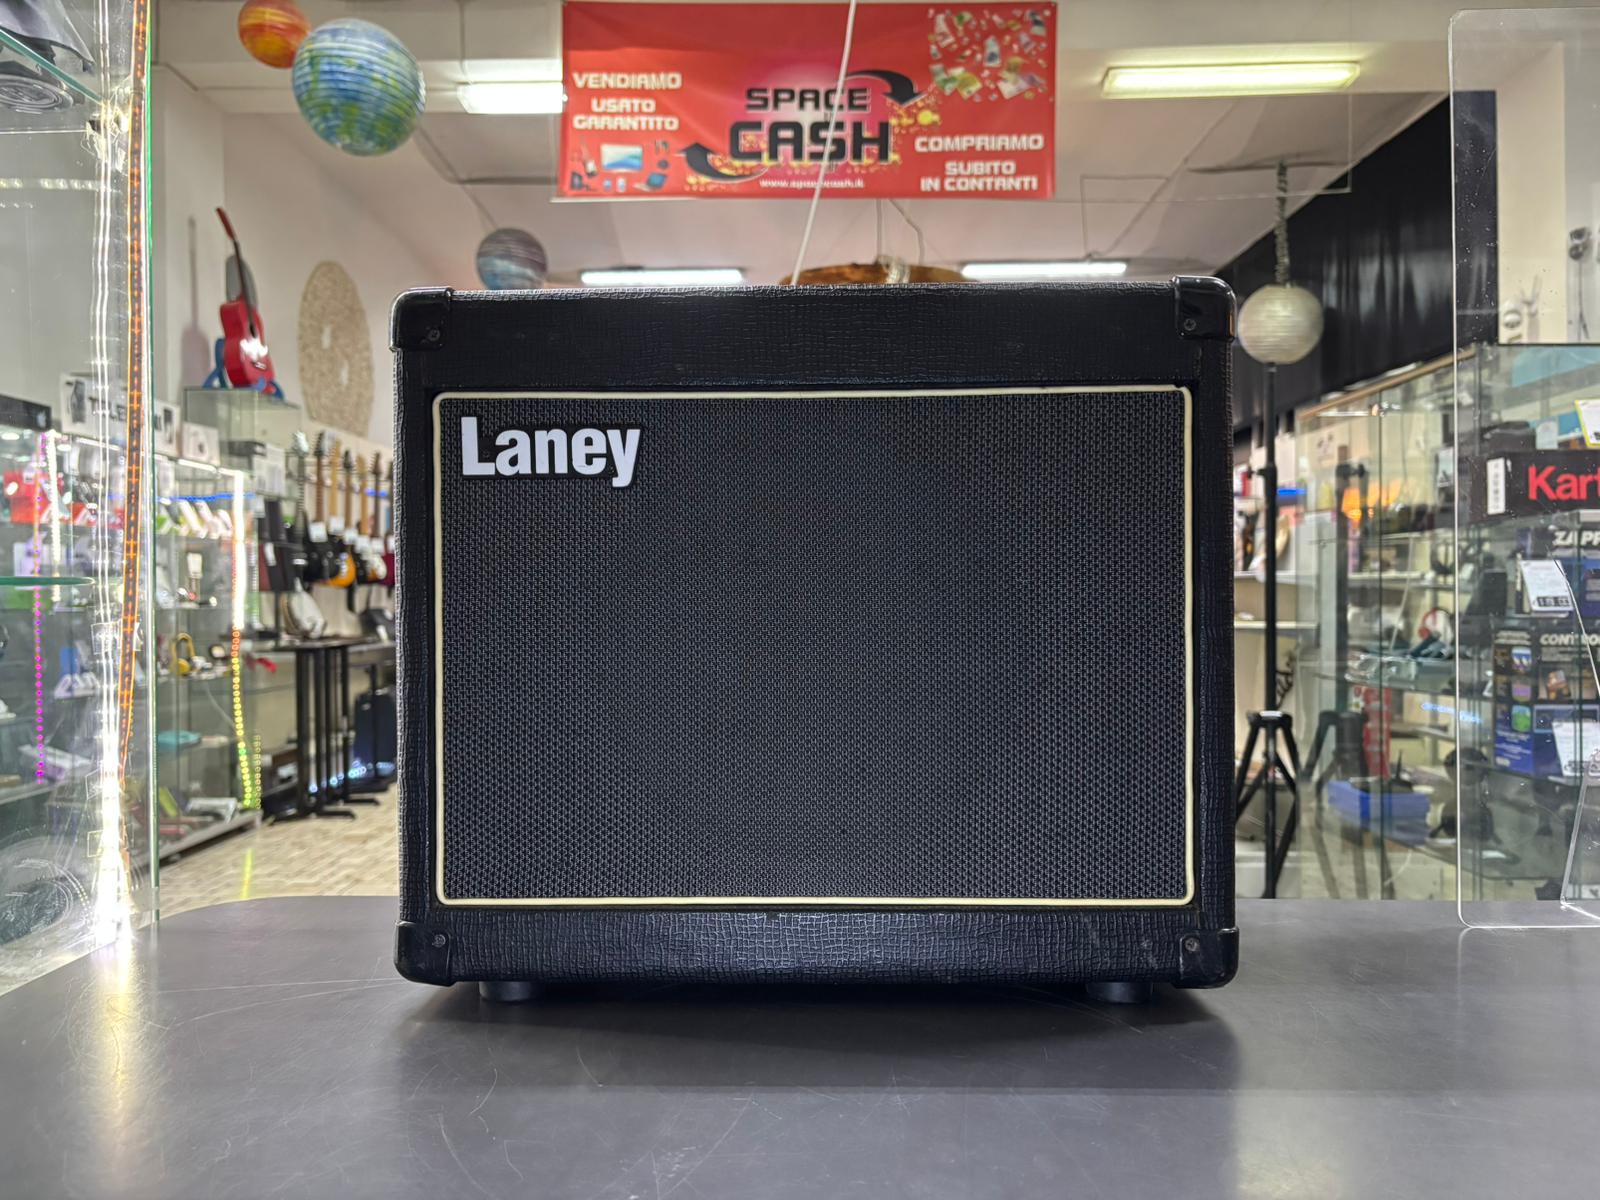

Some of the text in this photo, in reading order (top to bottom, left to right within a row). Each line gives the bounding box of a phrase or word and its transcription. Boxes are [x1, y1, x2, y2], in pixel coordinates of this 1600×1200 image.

[572, 71, 682, 90] VENDIAMO
[591, 97, 656, 113] USATO
[746, 88, 869, 112] SPACE
[573, 114, 680, 131] GARANTITO
[730, 121, 890, 162] CASH
[914, 132, 1044, 152] COMPRIAMO
[944, 160, 1017, 176] SUBITO
[920, 175, 1039, 192] IN CONTANTI
[461, 416, 641, 488] Laney
